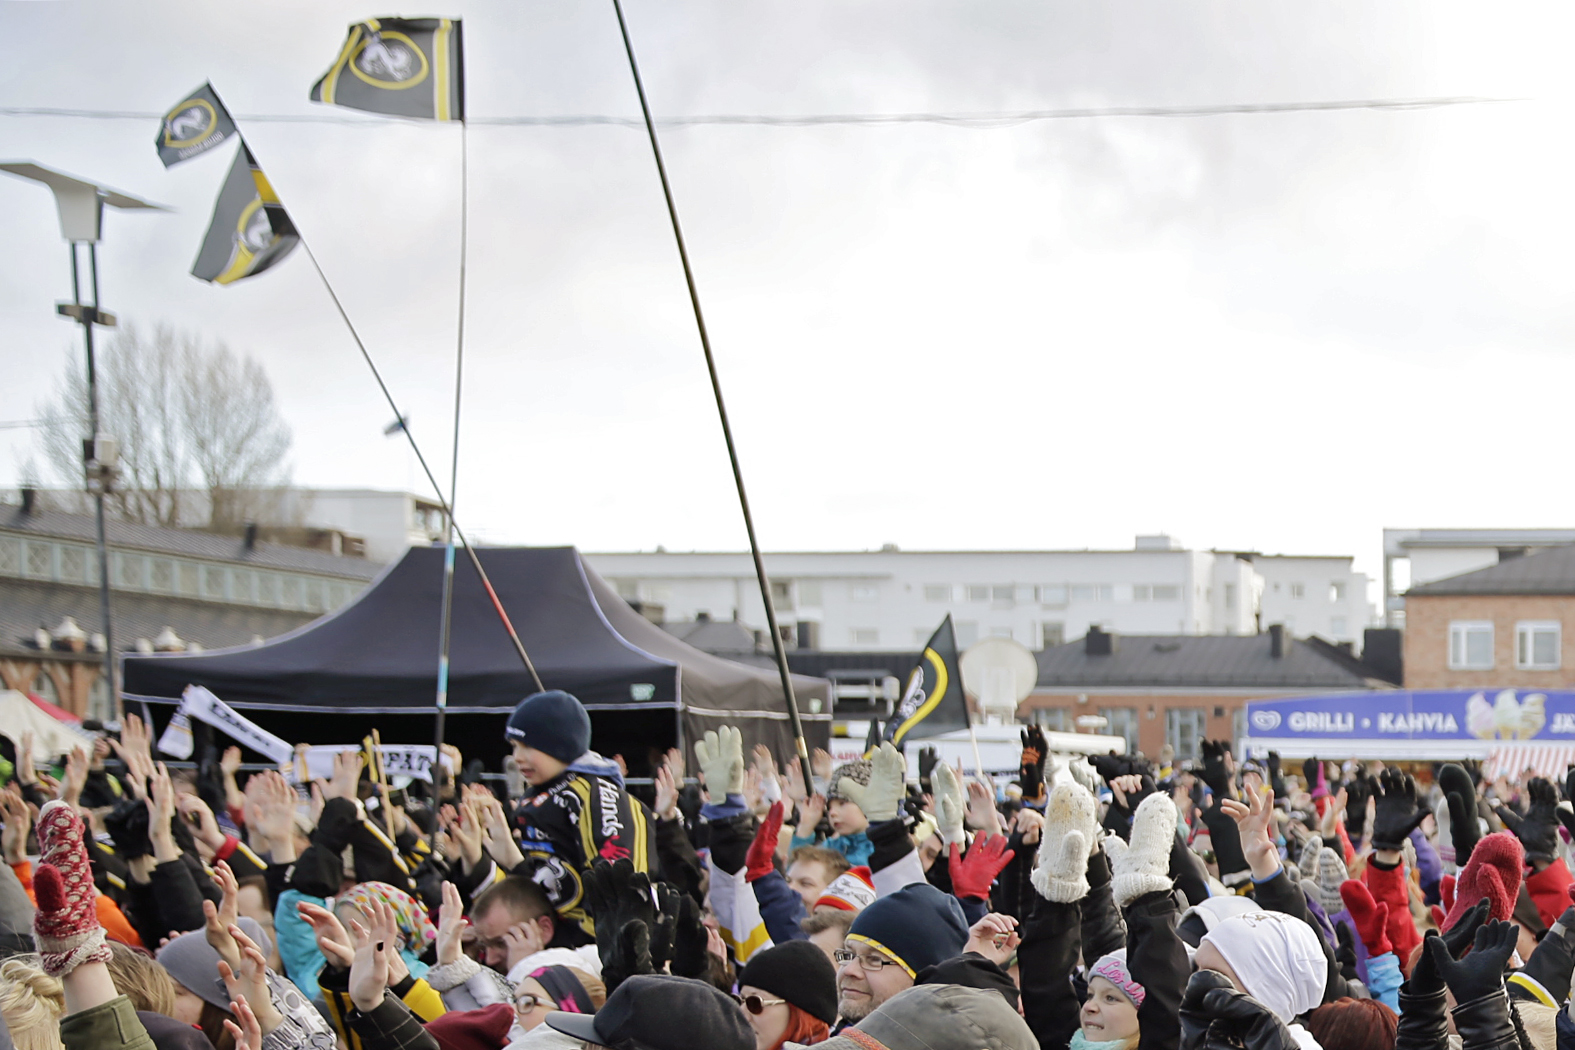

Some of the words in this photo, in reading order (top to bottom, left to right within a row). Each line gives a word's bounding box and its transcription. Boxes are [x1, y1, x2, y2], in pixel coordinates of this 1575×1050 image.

[1288, 711, 1355, 733] GRILLI
[1377, 711, 1459, 734] KAHVIA
[596, 777, 625, 837] Hands
[1096, 961, 1125, 984] Los
